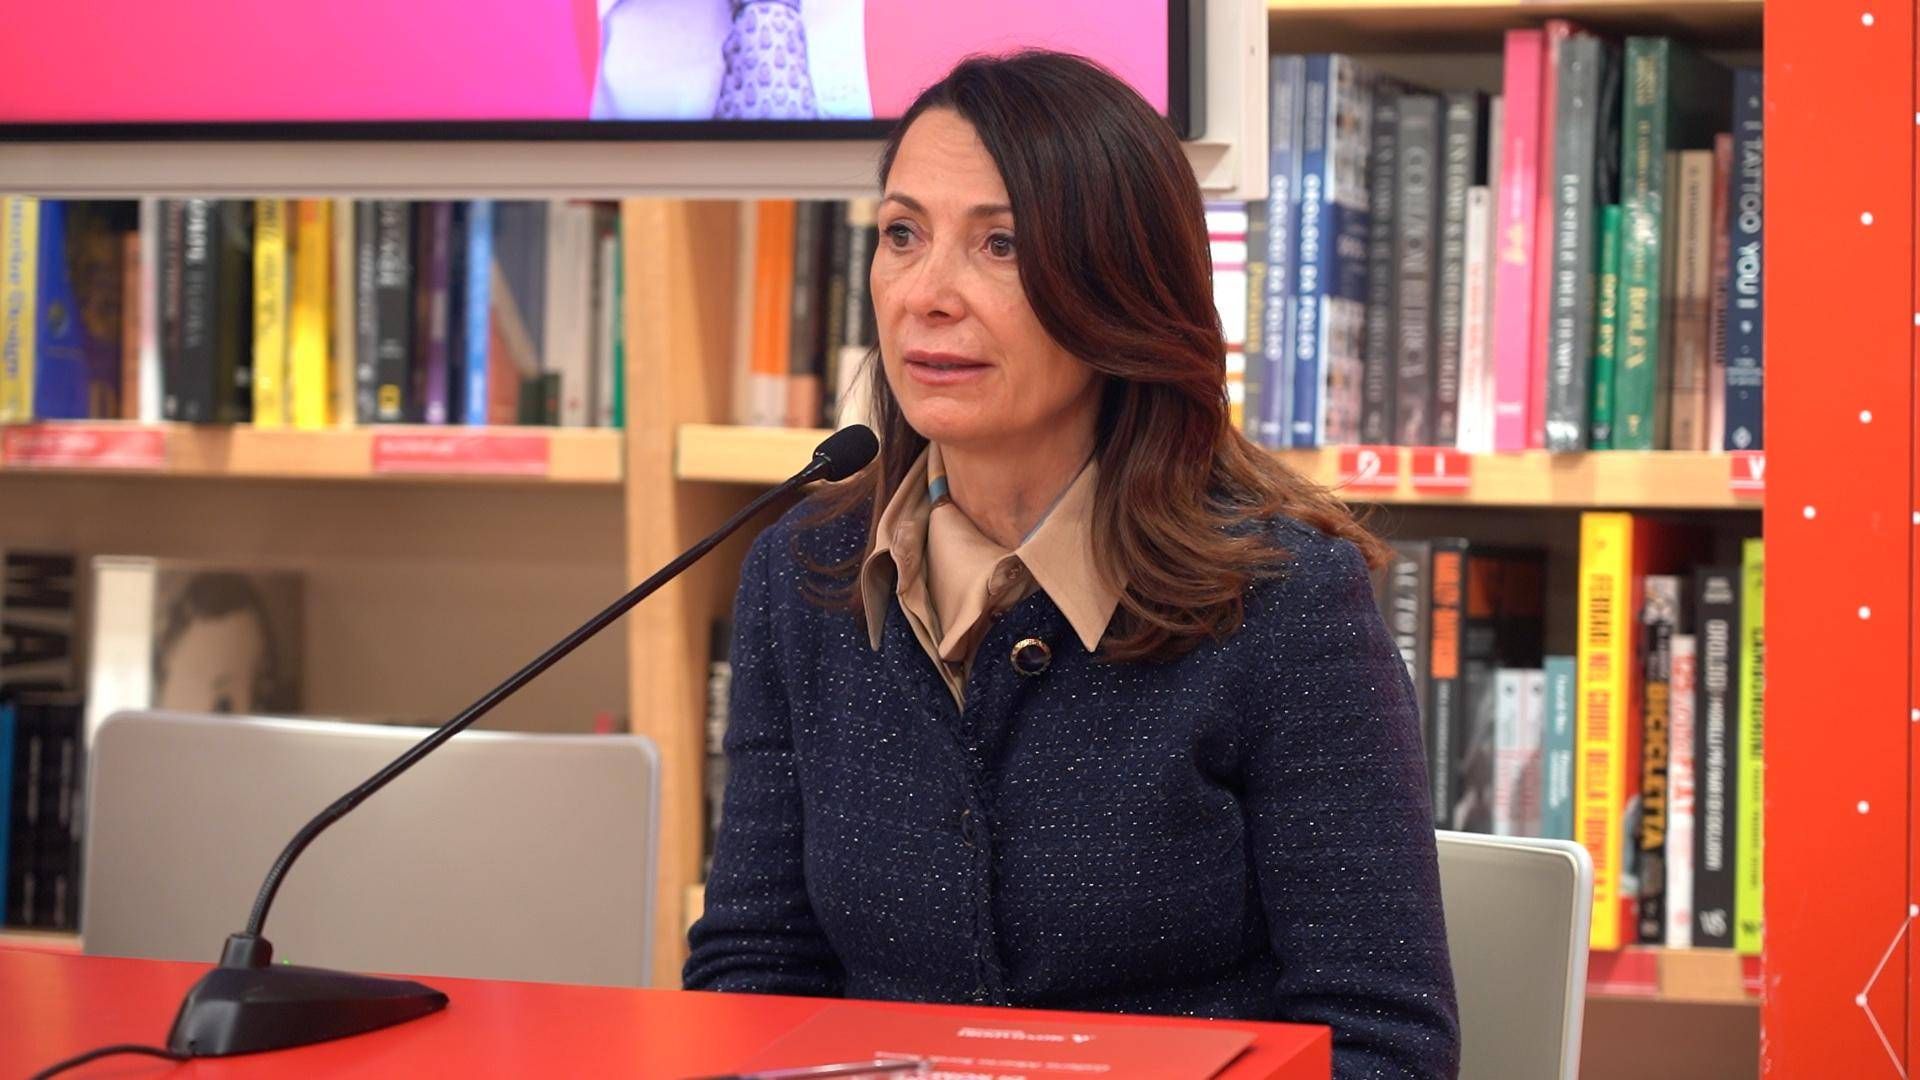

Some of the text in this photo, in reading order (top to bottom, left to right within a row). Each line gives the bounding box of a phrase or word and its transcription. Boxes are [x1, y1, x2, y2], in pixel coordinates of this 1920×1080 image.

[1562, 174, 1580, 204] LO
[1740, 138, 1762, 233] TATTOO
[1265, 175, 1289, 360] OROLOGI DA POLSO
[1298, 175, 1320, 360] OROLOGI DA POLSO
[1559, 271, 1575, 307] DEL
[1738, 242, 1762, 294] YOU
[1556, 318, 1574, 385] TEMPO
[1625, 286, 1648, 368] ROLEX
[1588, 574, 1615, 647] FERRARI
[1587, 652, 1612, 682] NEL
[1586, 690, 1611, 741] CUORE
[1585, 751, 1610, 799] DELLA
[1642, 682, 1667, 849] BICICLETTA
